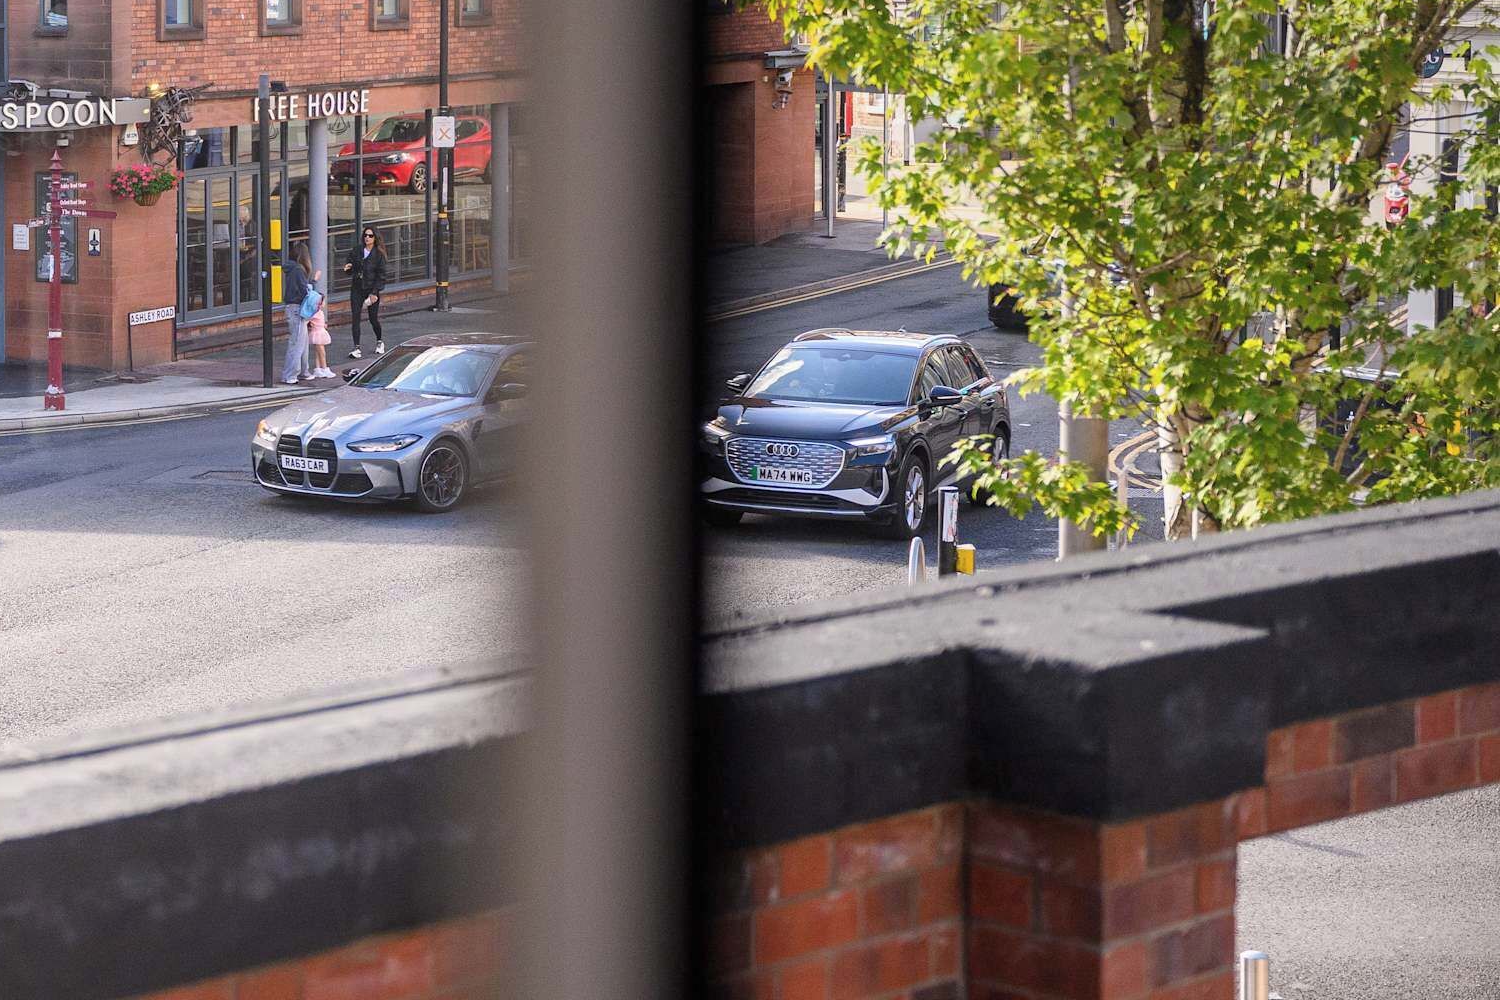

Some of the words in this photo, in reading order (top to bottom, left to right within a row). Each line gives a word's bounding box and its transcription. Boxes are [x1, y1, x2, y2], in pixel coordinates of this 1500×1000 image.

[308, 89, 370, 117] HOUSE
[130, 312, 156, 323] ASHLEY
[156, 308, 174, 319] ROAD
[285, 457, 306, 469] RA63
[307, 460, 325, 471] CAR
[759, 469, 786, 480] MA74
